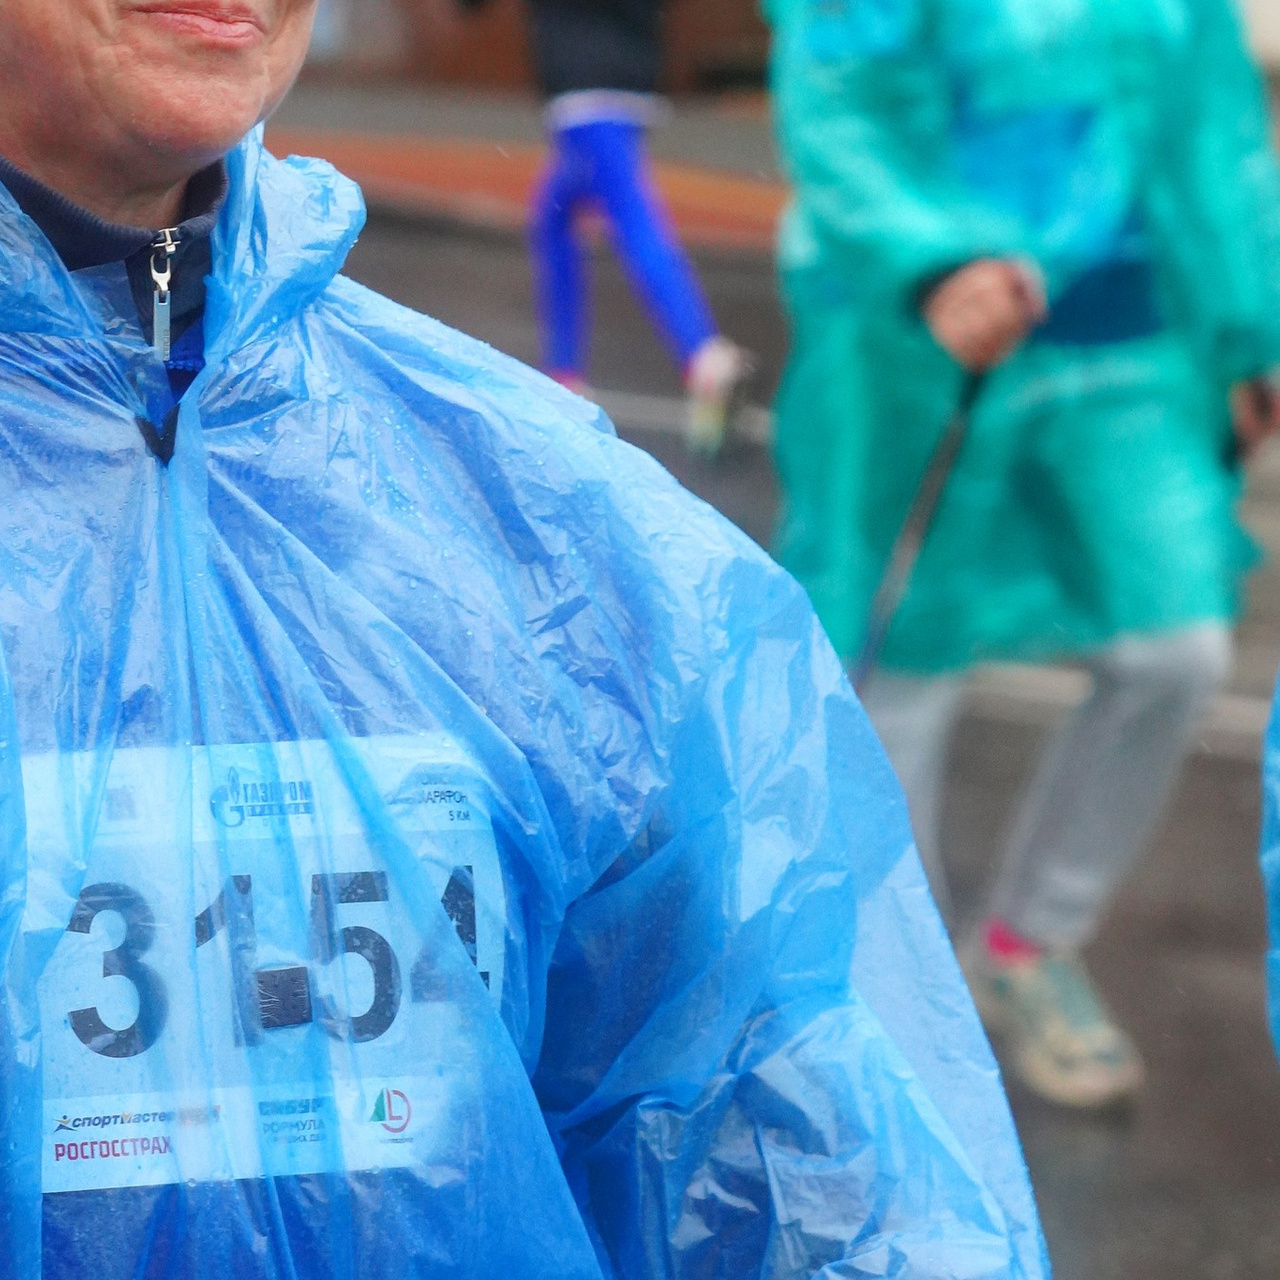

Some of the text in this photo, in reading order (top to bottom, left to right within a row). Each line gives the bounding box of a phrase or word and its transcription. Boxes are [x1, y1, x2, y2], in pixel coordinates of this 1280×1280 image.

[242, 780, 314, 804] ГАЗПОМ
[65, 864, 490, 1060] 3154
[54, 1135, 173, 1162] РОСГОССТРАХ
